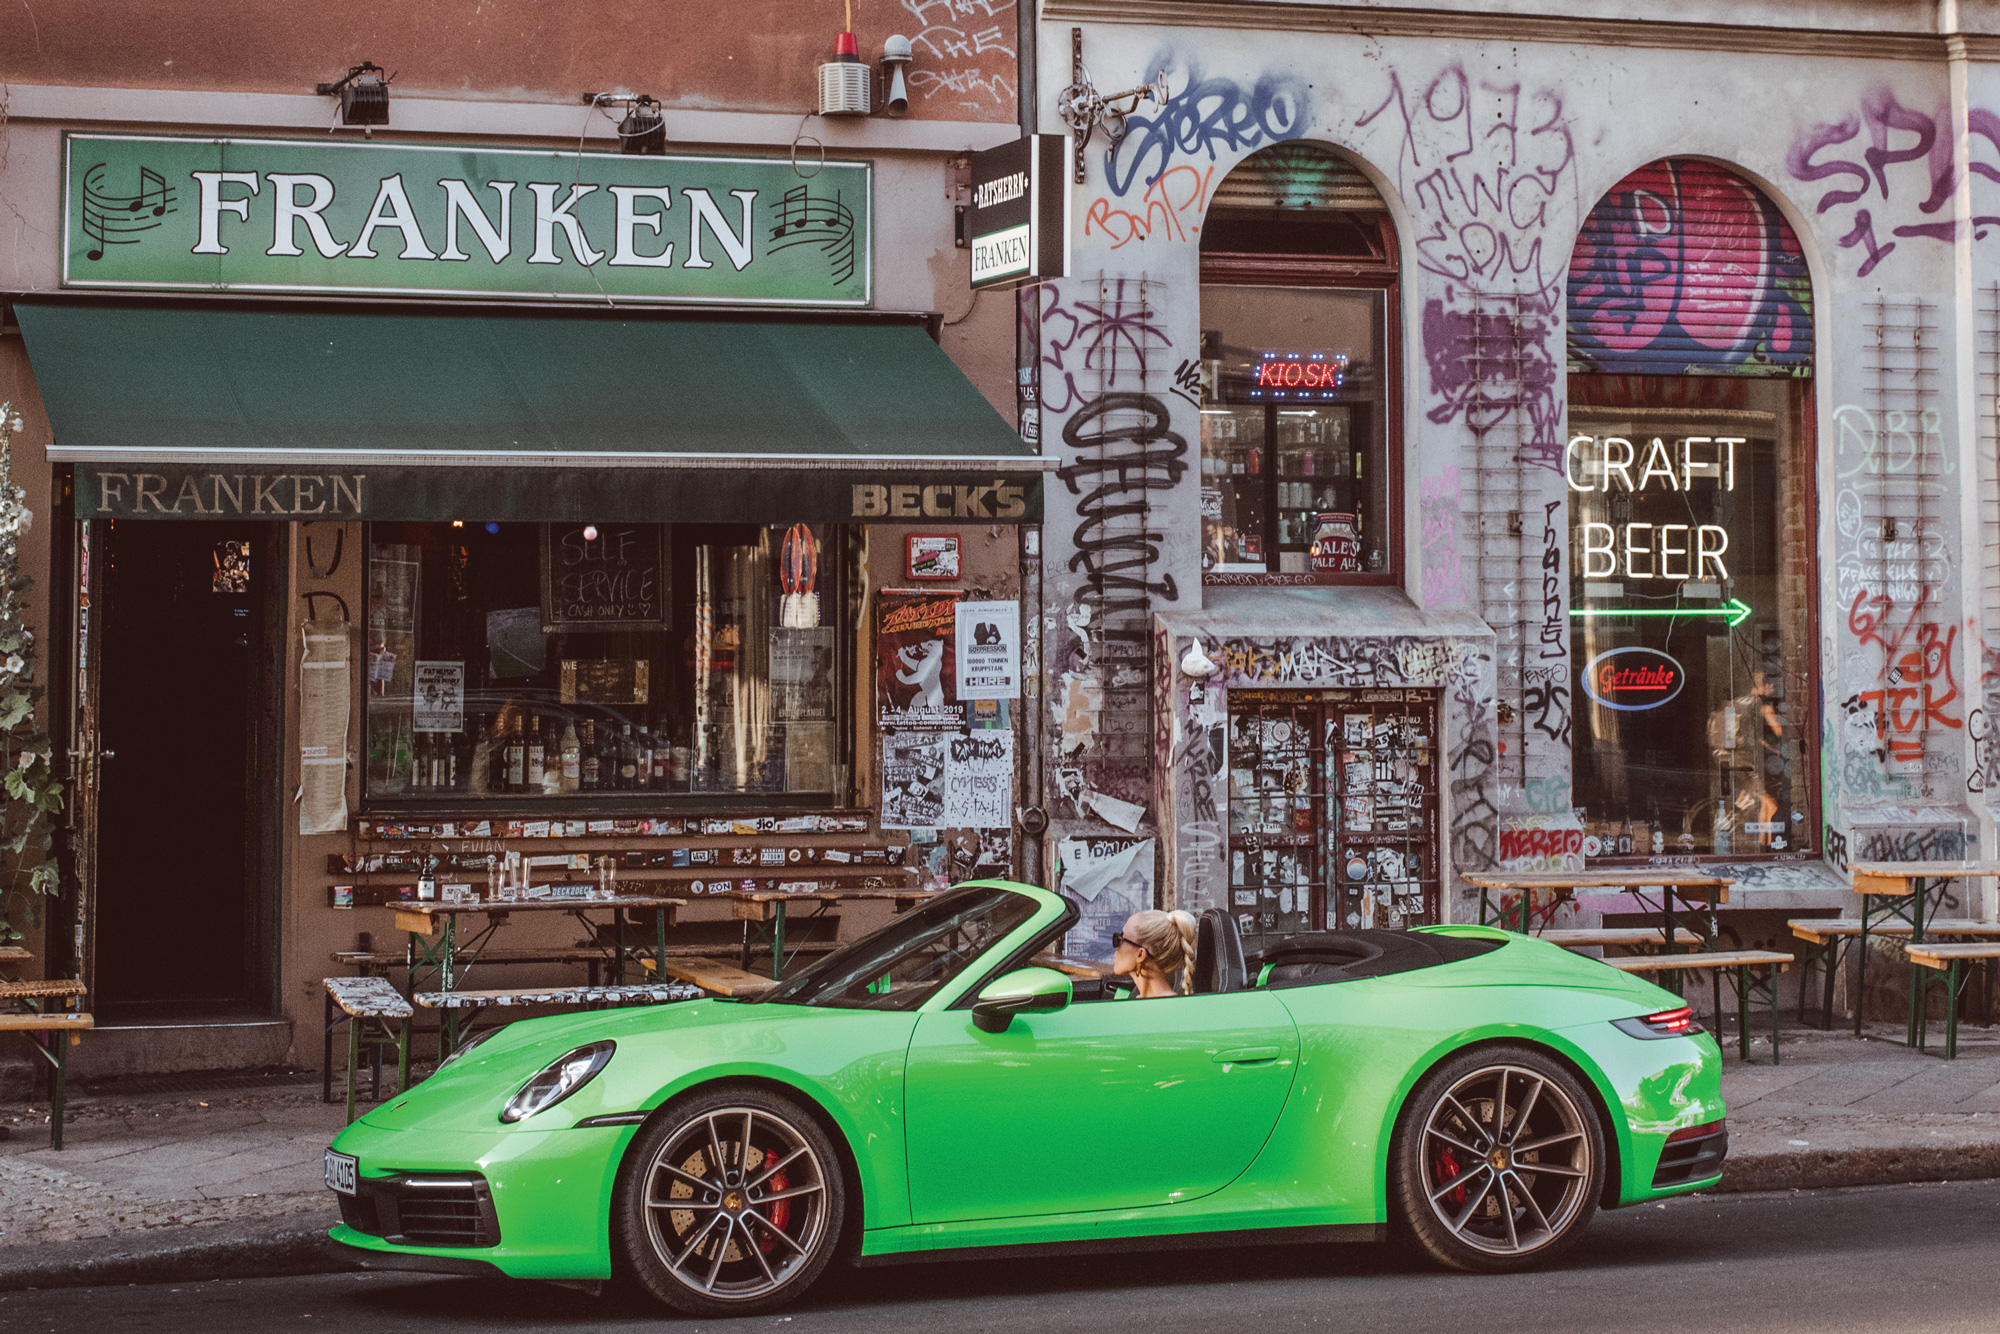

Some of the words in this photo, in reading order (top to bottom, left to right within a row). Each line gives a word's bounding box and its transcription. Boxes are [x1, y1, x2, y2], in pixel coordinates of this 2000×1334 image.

[978, 171, 1025, 209] RATSHERRN
[190, 170, 759, 273] FRANKEN
[975, 235, 1027, 272] FRANKEN
[1260, 362, 1338, 387] KIOSK
[1566, 436, 1746, 492] CRAFT
[96, 472, 366, 515] FRANKEN
[851, 479, 1026, 518] BECK'S
[1311, 557, 1336, 571] PALE
[1312, 540, 1358, 557] DALE'S
[1583, 522, 1728, 580] BEER
[1600, 664, 1674, 692] Getränke
[907, 706, 939, 716] August
[943, 706, 963, 714] 2019
[551, 886, 594, 897] DECK2DECK
[709, 882, 731, 893] ZON
